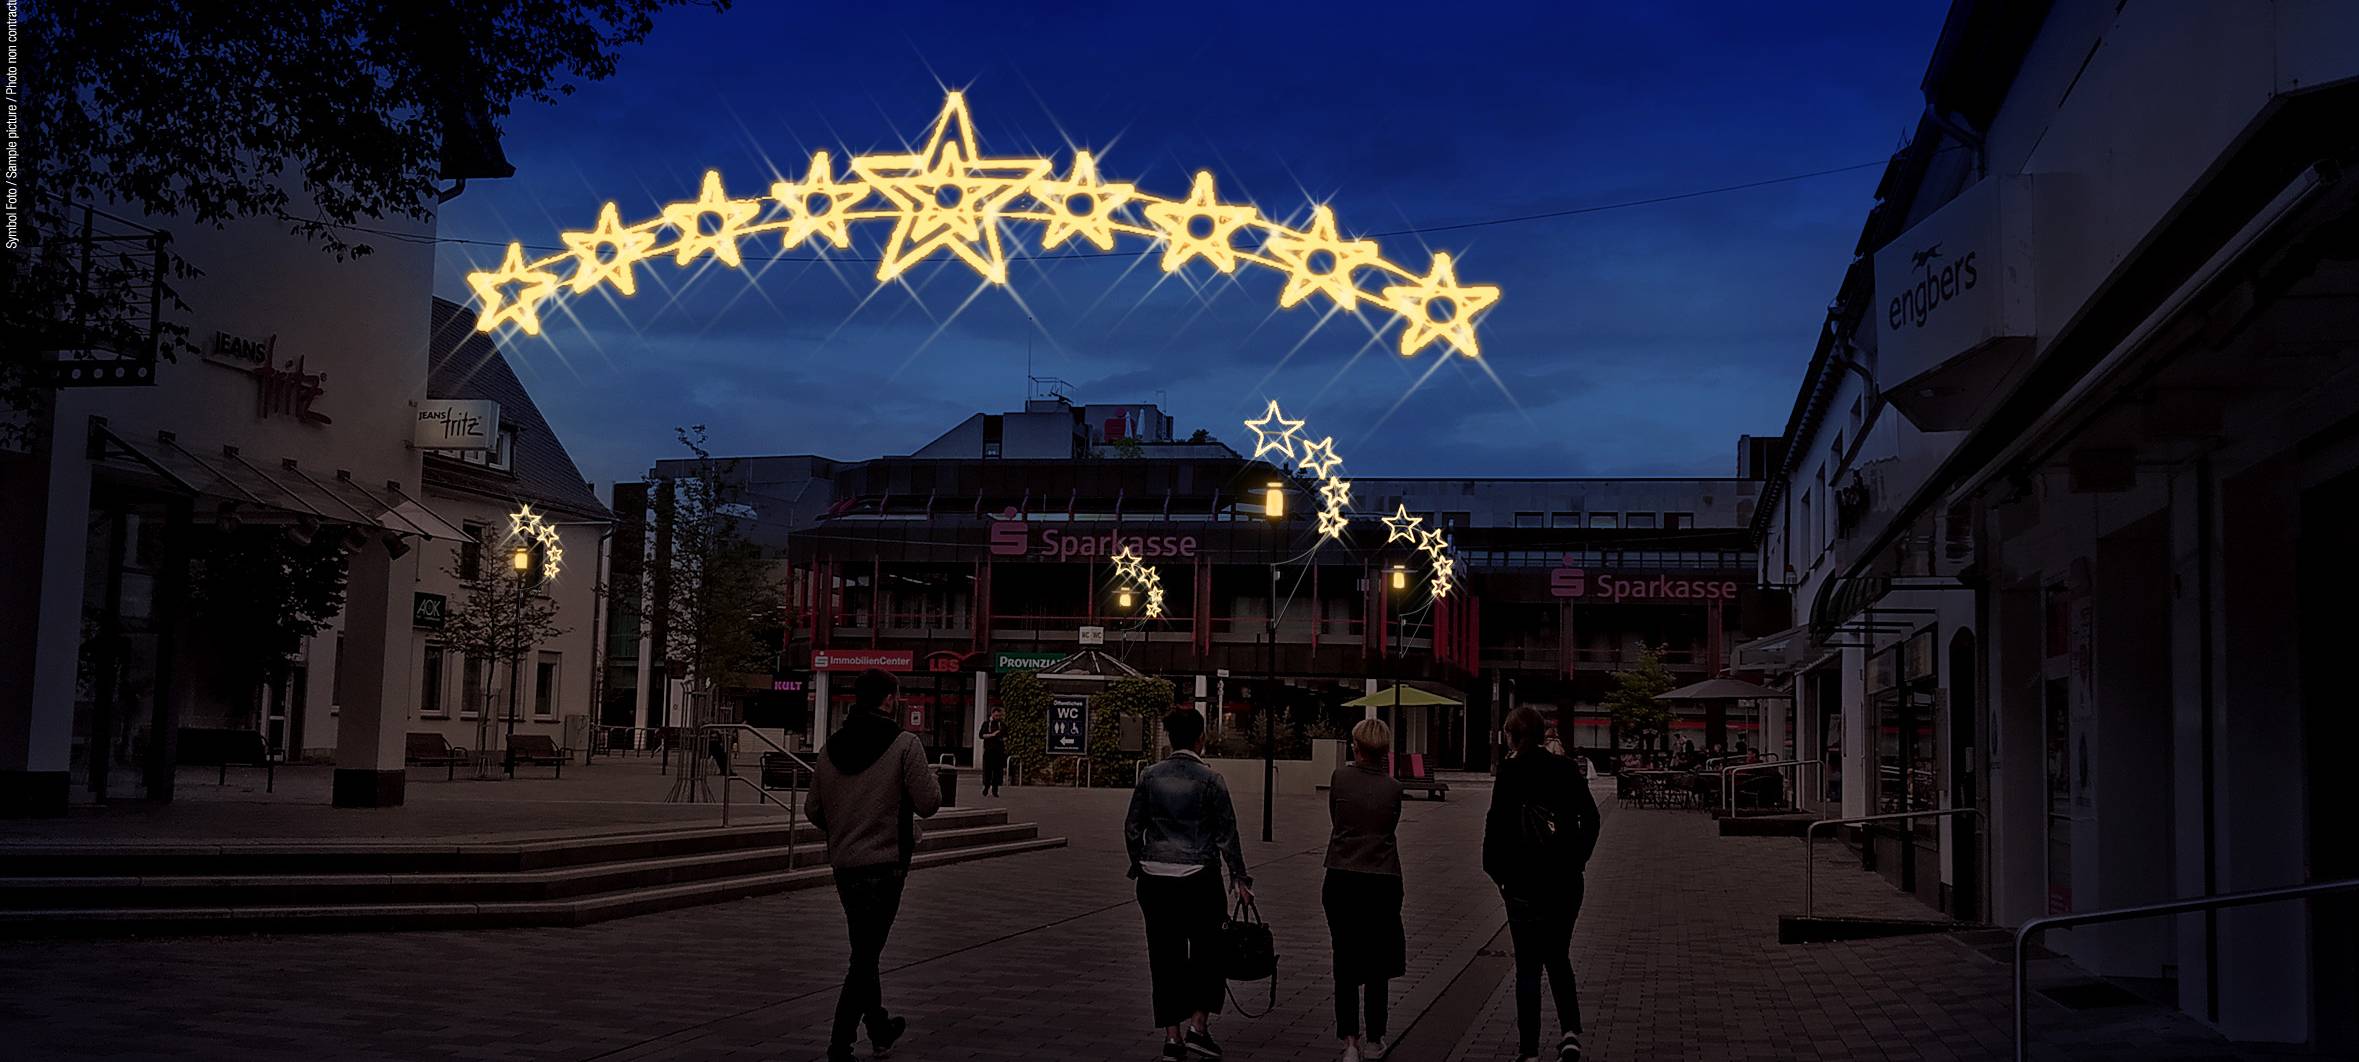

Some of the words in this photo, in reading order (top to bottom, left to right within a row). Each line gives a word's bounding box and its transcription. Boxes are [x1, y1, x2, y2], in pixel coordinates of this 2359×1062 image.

[1889, 251, 1977, 330] engbers
[215, 331, 266, 363] JEANS
[253, 334, 332, 424] fritz
[418, 411, 446, 421] JEANS
[440, 407, 484, 439] fritz
[1041, 527, 1198, 563] Sparkasse
[1596, 573, 1738, 603] Sparkasse
[416, 598, 441, 617] AOK
[830, 655, 911, 666] ImmobilienCenter
[929, 657, 961, 673] LBS
[774, 680, 803, 692] KULT
[1057, 707, 1079, 719] WC
